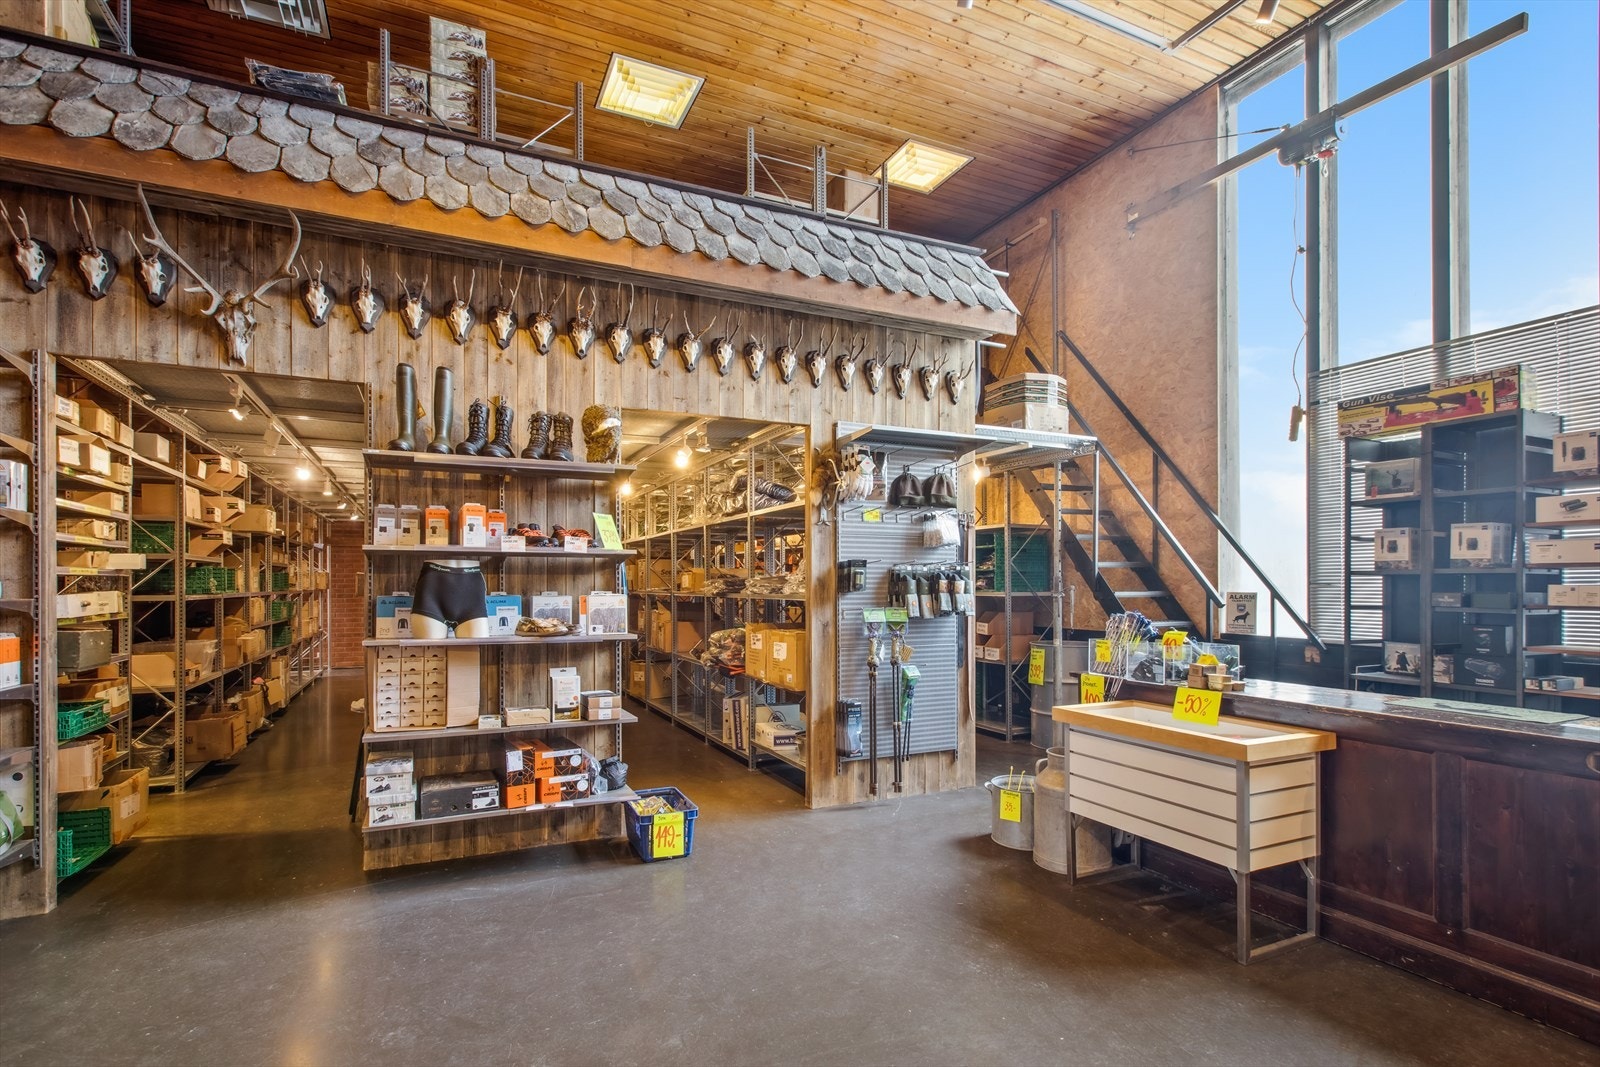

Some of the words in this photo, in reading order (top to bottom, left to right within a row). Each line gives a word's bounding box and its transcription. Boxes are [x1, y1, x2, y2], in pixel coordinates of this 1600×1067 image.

[1342, 399, 1365, 408] Gun
[1368, 393, 1395, 403] Vise
[1177, 694, 1212, 716] -50%
